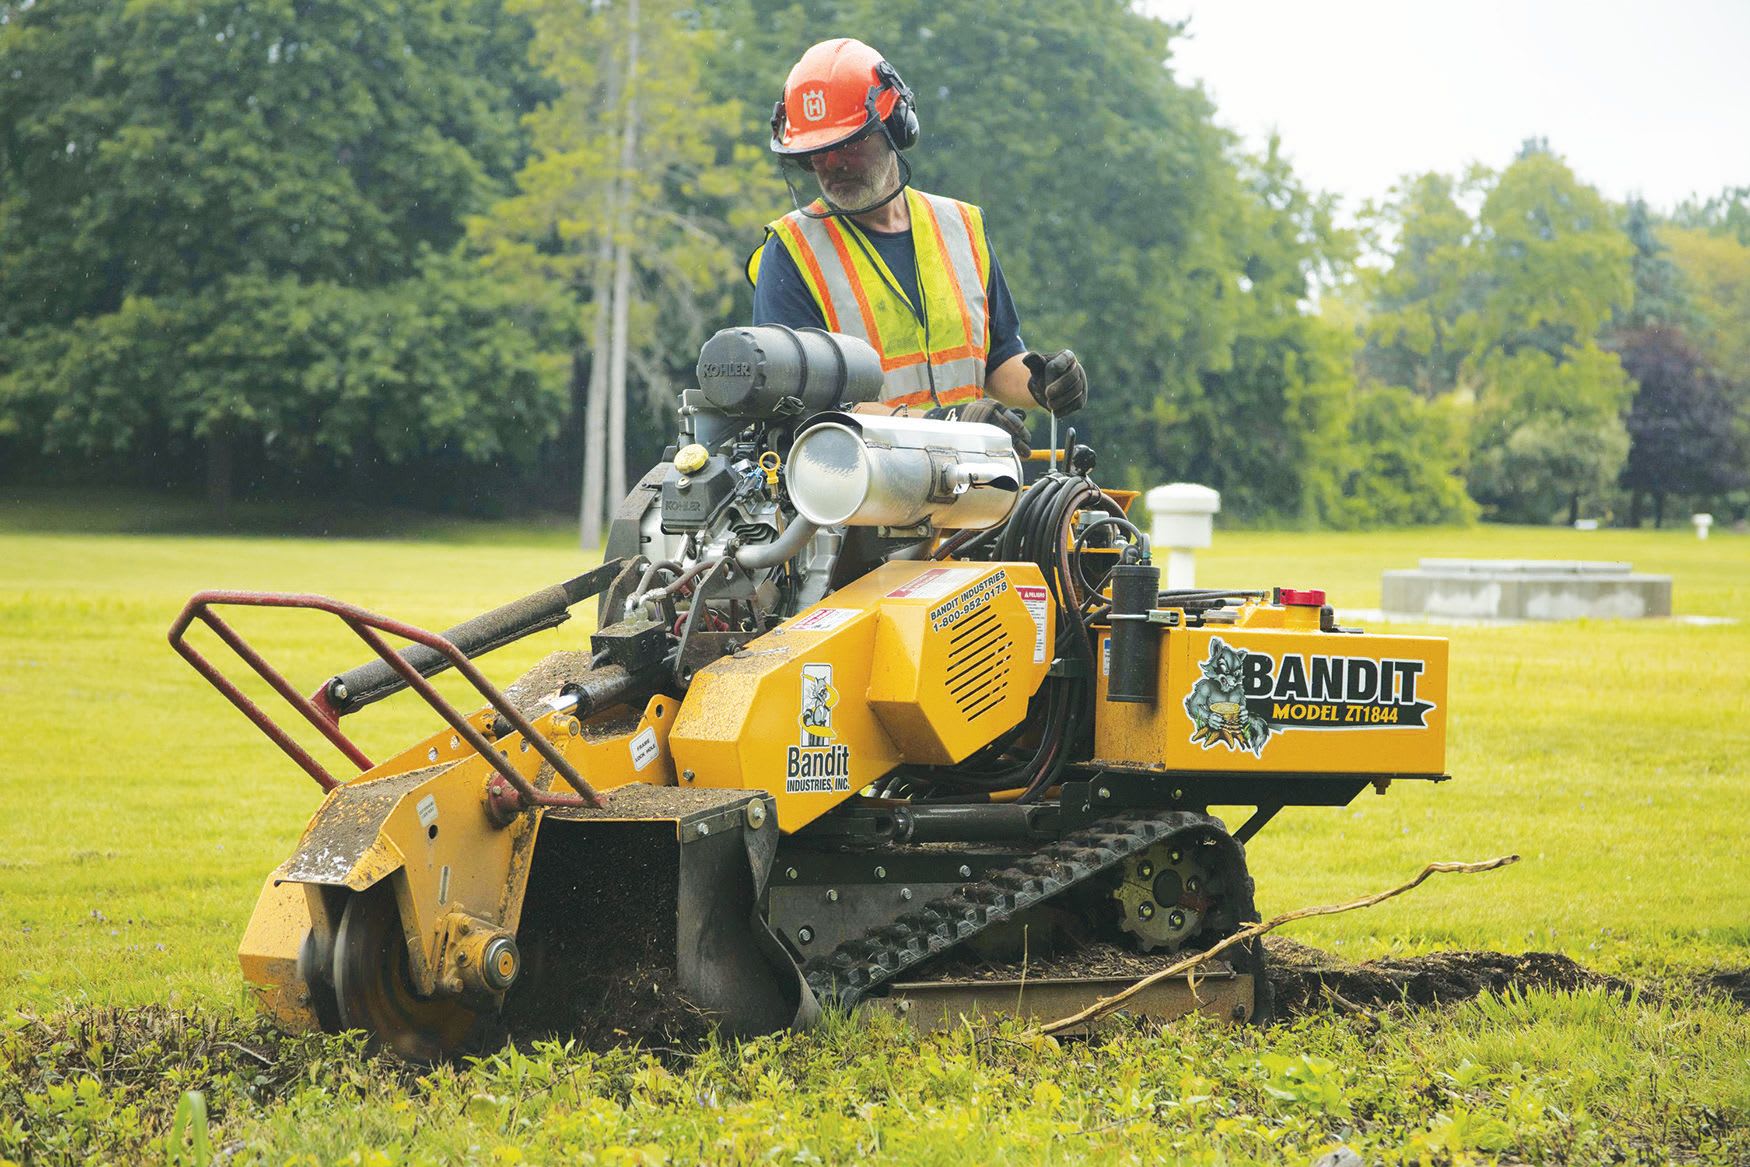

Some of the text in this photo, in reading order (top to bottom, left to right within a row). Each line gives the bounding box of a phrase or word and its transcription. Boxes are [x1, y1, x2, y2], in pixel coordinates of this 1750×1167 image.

[703, 361, 751, 378] KOHLER
[665, 500, 701, 511] KOHLER
[930, 597, 959, 621] BANDIT
[960, 570, 1006, 602] INDUSTRIES
[1028, 591, 1046, 599] PELIGRO
[933, 581, 1008, 632] 1-800-952-0178
[1242, 654, 1424, 703] BANDIT
[1272, 703, 1399, 724] MODEL ZT1844
[787, 745, 850, 778] Bandit
[786, 777, 850, 793] INDUSTRIES, INC.
